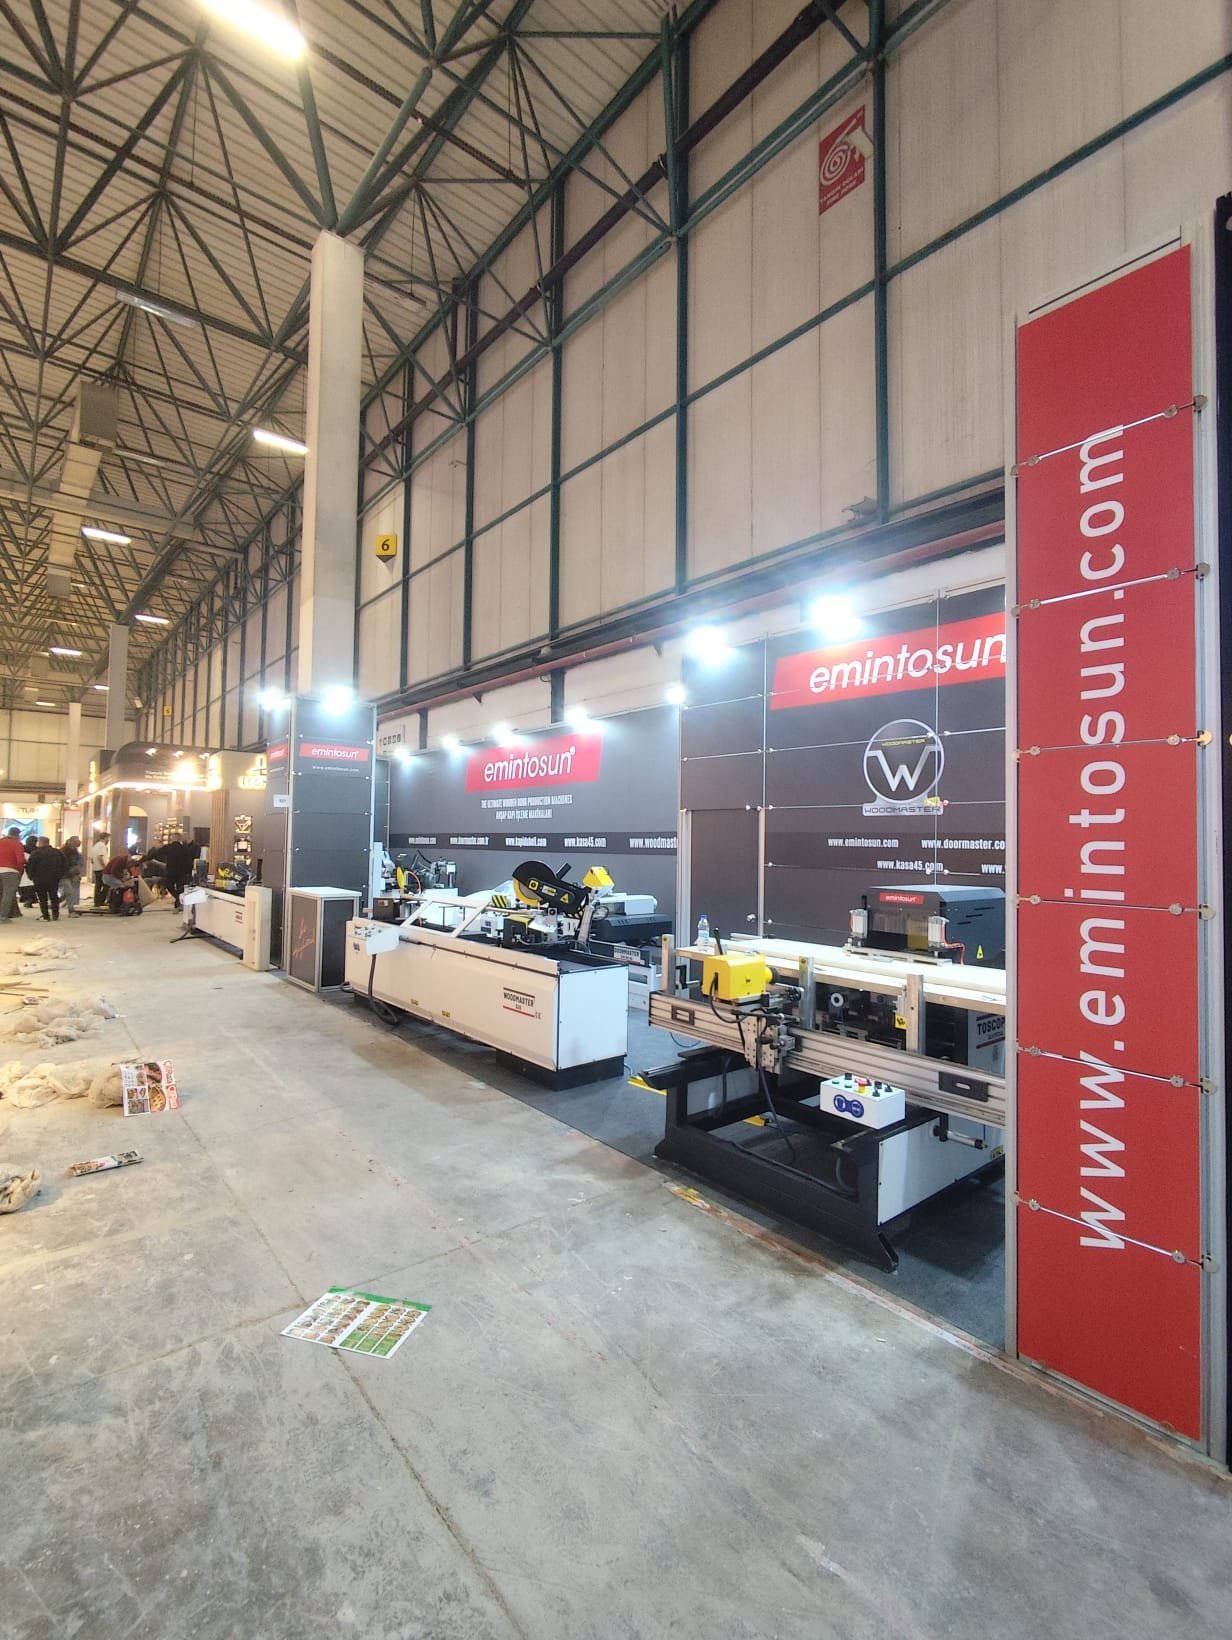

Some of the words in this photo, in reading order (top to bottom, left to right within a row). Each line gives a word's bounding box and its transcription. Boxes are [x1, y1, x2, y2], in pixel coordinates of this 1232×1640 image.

[381, 538, 391, 552] 6
[810, 633, 1006, 693] emintosun
[311, 747, 359, 759] emintosun
[864, 806, 942, 814] WOODMASTER
[564, 837, 607, 848] www.kasa45.com
[828, 837, 899, 848] www.emintosun.com
[1064, 424, 1127, 1250] www.emintosun.com
[877, 860, 944, 872] www.kasa45.com
[503, 991, 535, 1008] WOODMASTER
